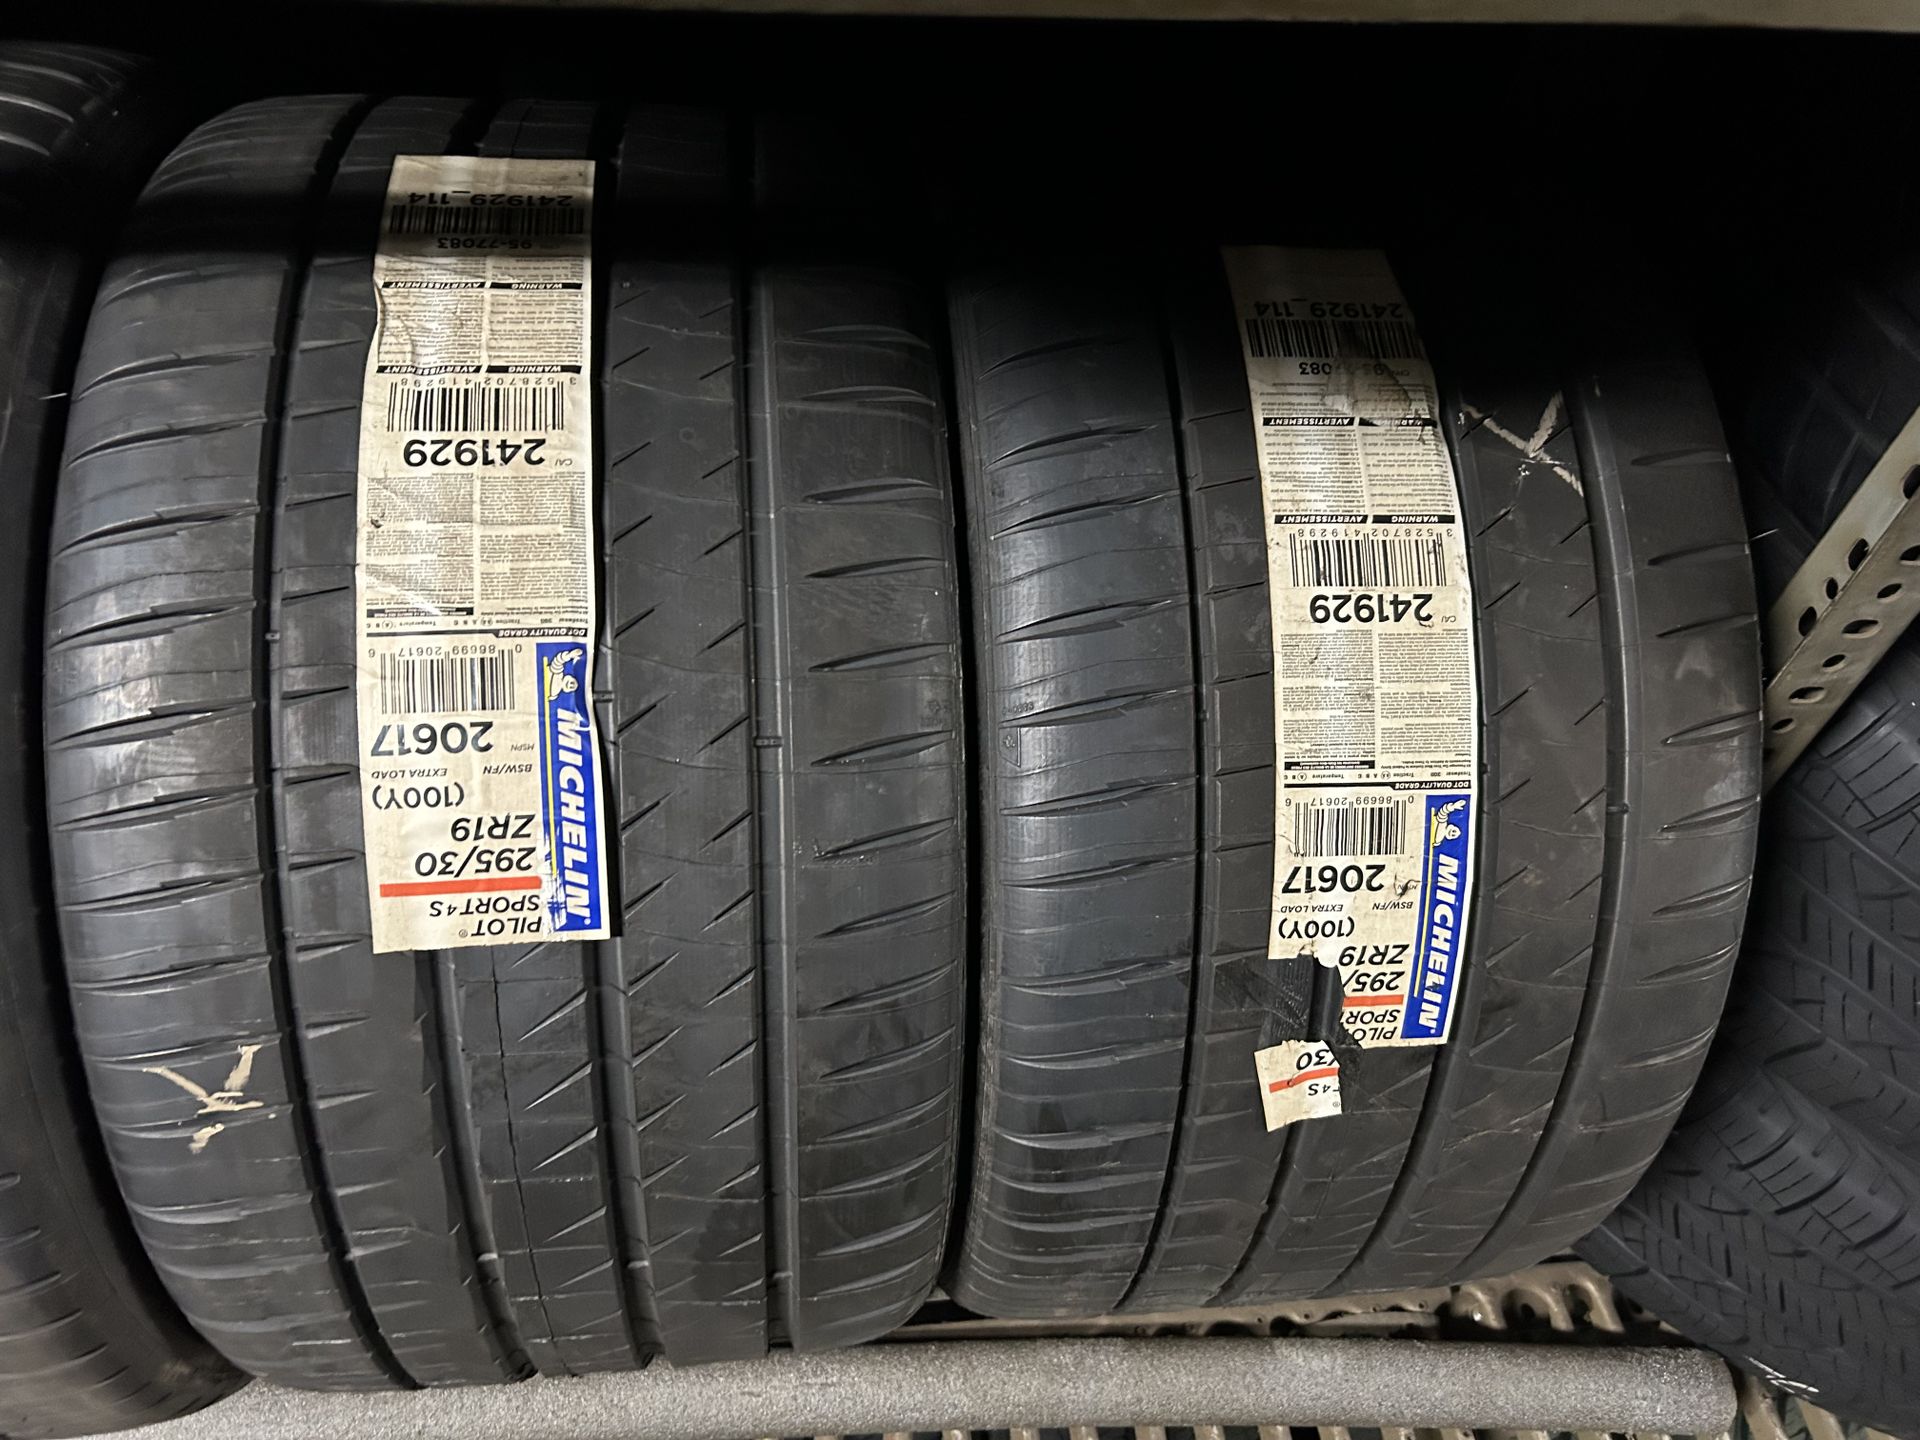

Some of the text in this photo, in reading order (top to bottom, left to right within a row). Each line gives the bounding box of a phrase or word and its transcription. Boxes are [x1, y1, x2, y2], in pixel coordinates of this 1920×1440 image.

[408, 191, 573, 206] 241929_114
[437, 237, 532, 249] 95-77083
[389, 281, 481, 289] AVERTISSEMENT
[1253, 297, 1402, 319] 241929_114
[384, 365, 477, 375] AVERTISSEMENT
[508, 365, 562, 373] WARNING
[1269, 417, 1350, 426] AVERTISSEMENT
[403, 438, 572, 467] CAI 241929
[1280, 515, 1364, 524] AVERTISSEMENT
[1391, 514, 1440, 524] WARNING
[1309, 592, 1457, 624] CAI 241929
[498, 629, 528, 638] GRADE
[530, 628, 567, 637] QUALITY
[370, 720, 494, 757] 20617
[510, 742, 535, 752] MSPN
[371, 767, 448, 780] EXTRA LOAD
[483, 763, 533, 776] BSW/FN
[1394, 780, 1470, 790] DOT QUALITY GRADE
[372, 782, 464, 810] (100Y)
[1356, 796, 1392, 807] 86699
[1311, 797, 1348, 808] 20617
[556, 707, 591, 918] MICHELIN
[451, 813, 535, 842] ZR19
[415, 845, 536, 878] 295/30
[1281, 864, 1386, 894] 20617
[1280, 903, 1344, 914] EXTRA LOAD
[1372, 900, 1413, 911] BSW/FN
[1278, 917, 1355, 939] (100Y)
[1417, 854, 1459, 1027] MICHELIN
[1338, 943, 1410, 967] ZR19
